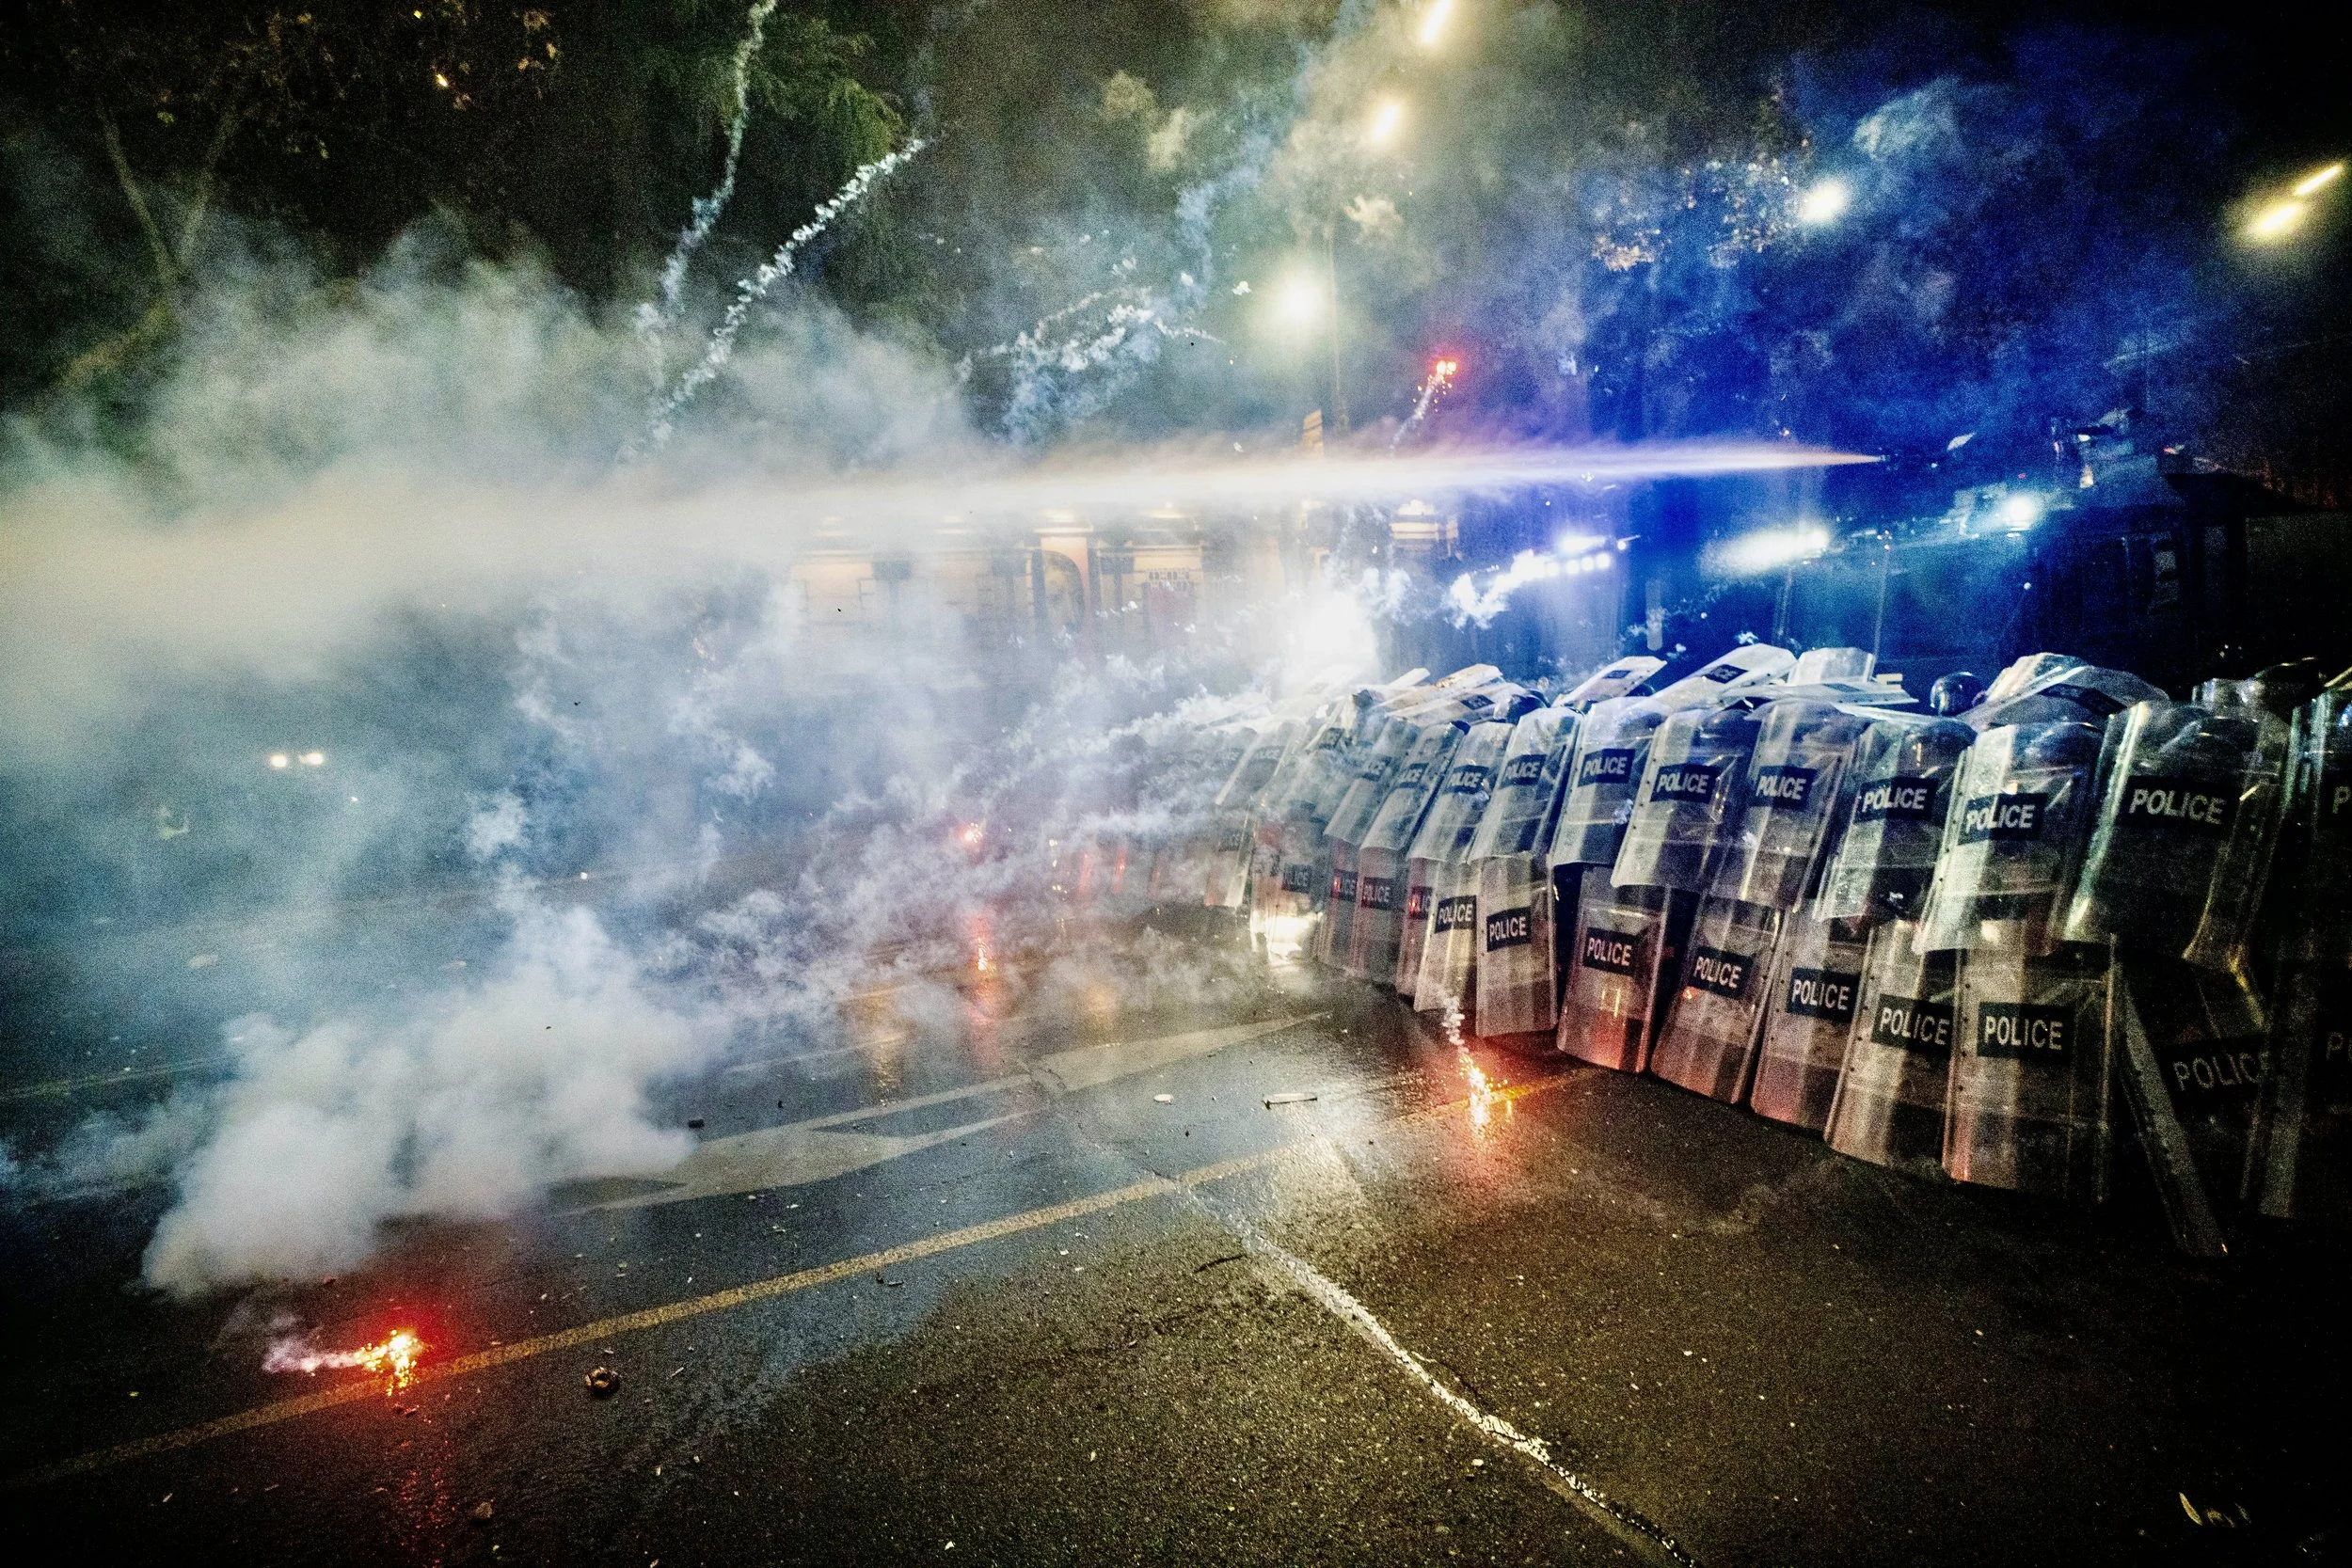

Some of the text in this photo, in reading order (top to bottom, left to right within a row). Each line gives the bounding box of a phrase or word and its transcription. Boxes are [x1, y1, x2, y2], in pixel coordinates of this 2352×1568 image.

[1581, 756, 1628, 778] POLICE
[1656, 772, 1708, 794] POLICE
[1756, 775, 1806, 800] POLICE
[1862, 787, 1928, 813] POLICE
[2128, 788, 2228, 825] POLICE
[1965, 803, 2035, 834] POLICE
[1438, 902, 1473, 925] POLICE
[1489, 915, 1527, 942] POLICE
[1586, 937, 1633, 967] POLICE
[1693, 956, 1742, 989] POLICE
[1790, 978, 1851, 1011] POLICE
[1879, 1006, 1950, 1046] POLICE
[1984, 1015, 2064, 1051] POLICE
[2173, 1052, 2259, 1092] POLIC
